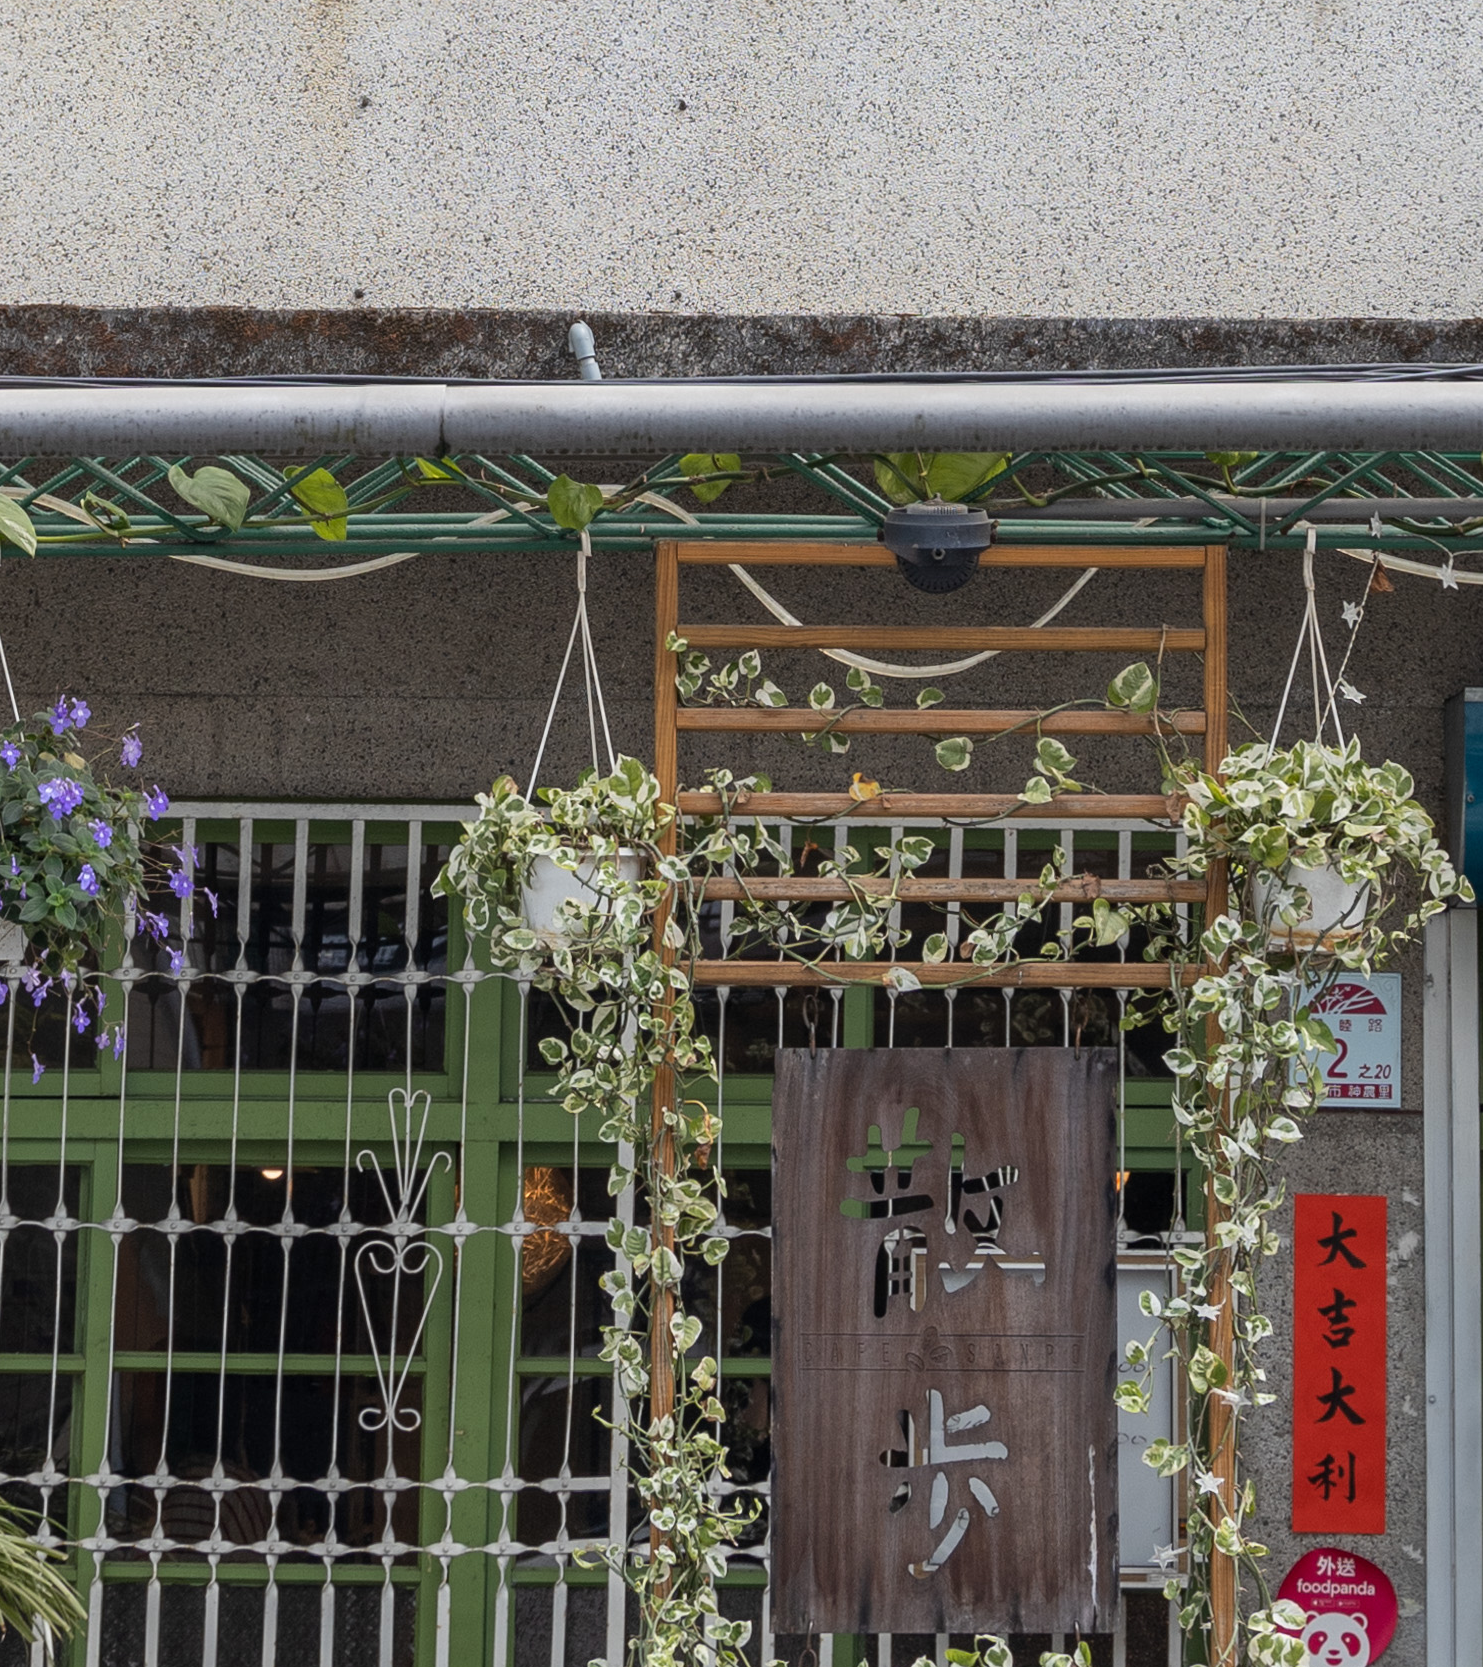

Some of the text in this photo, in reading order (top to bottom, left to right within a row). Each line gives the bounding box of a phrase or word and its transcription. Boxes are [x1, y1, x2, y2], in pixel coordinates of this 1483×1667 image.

[1307, 1210, 1367, 1504] 大吉大利
[1317, 1555, 1357, 1578] 外送
[1296, 1577, 1376, 1598] foodpanda
